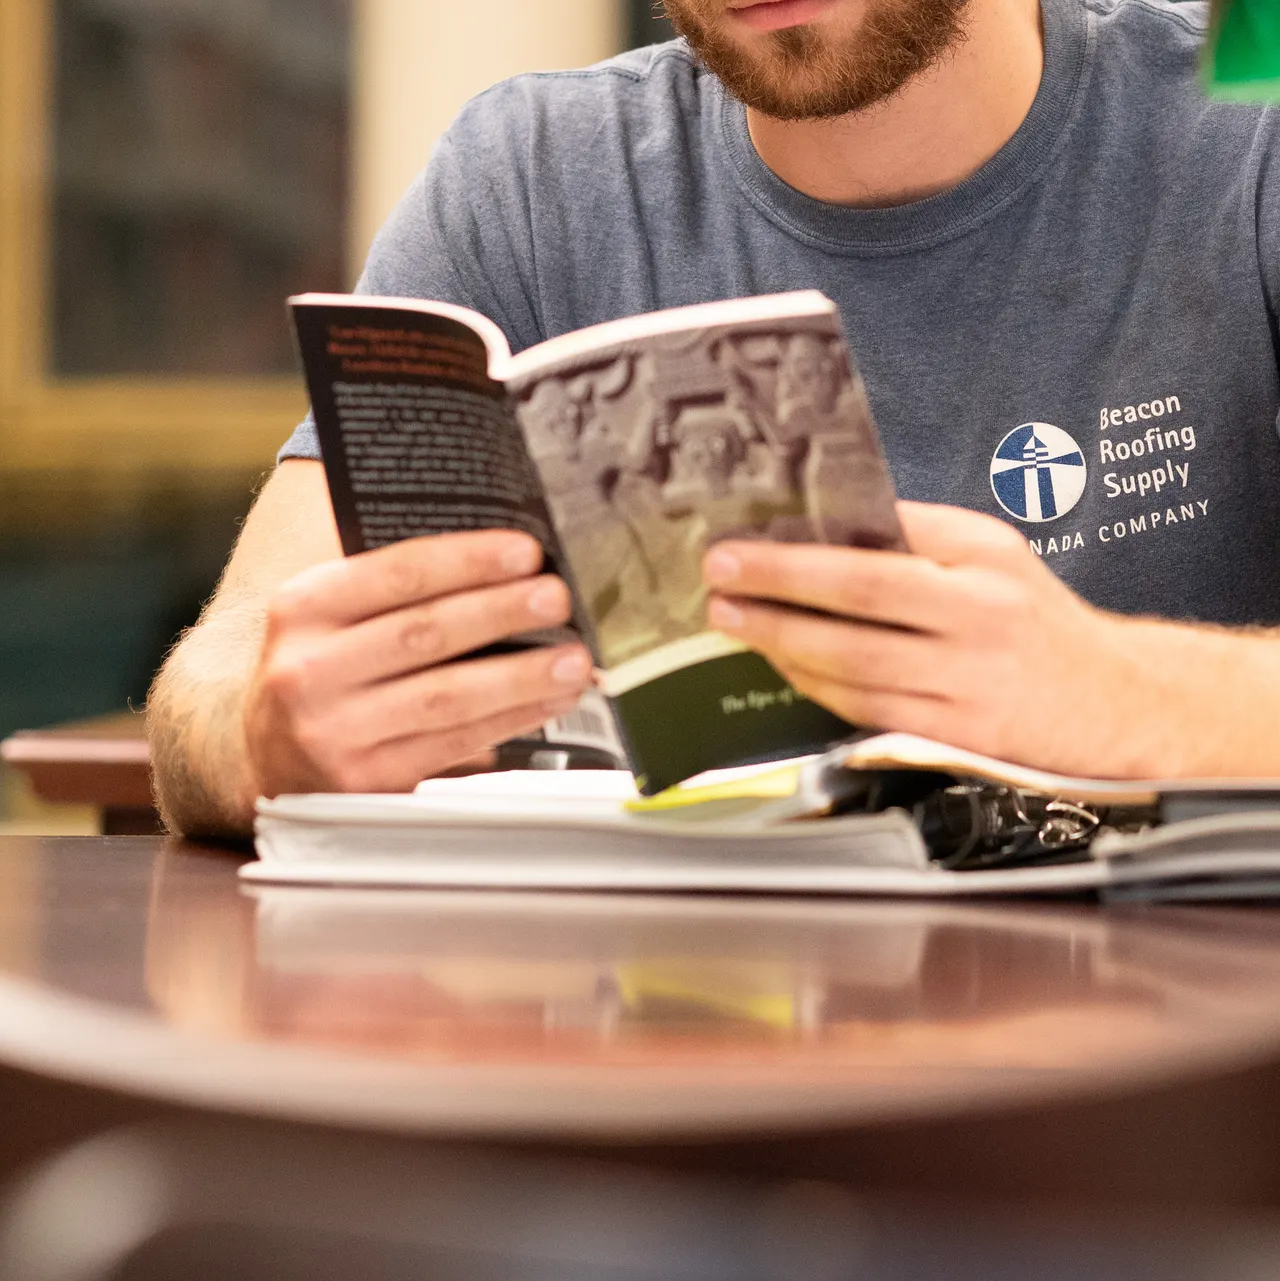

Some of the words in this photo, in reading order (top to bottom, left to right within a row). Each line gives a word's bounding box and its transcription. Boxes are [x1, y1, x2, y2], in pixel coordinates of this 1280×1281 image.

[1099, 395, 1181, 430] Beacon
[1099, 426, 1196, 464] Roofing
[1103, 459, 1189, 498] Supply
[1029, 531, 1085, 556] NADA
[1098, 499, 1210, 543] COMPANY
[721, 694, 746, 714] The
